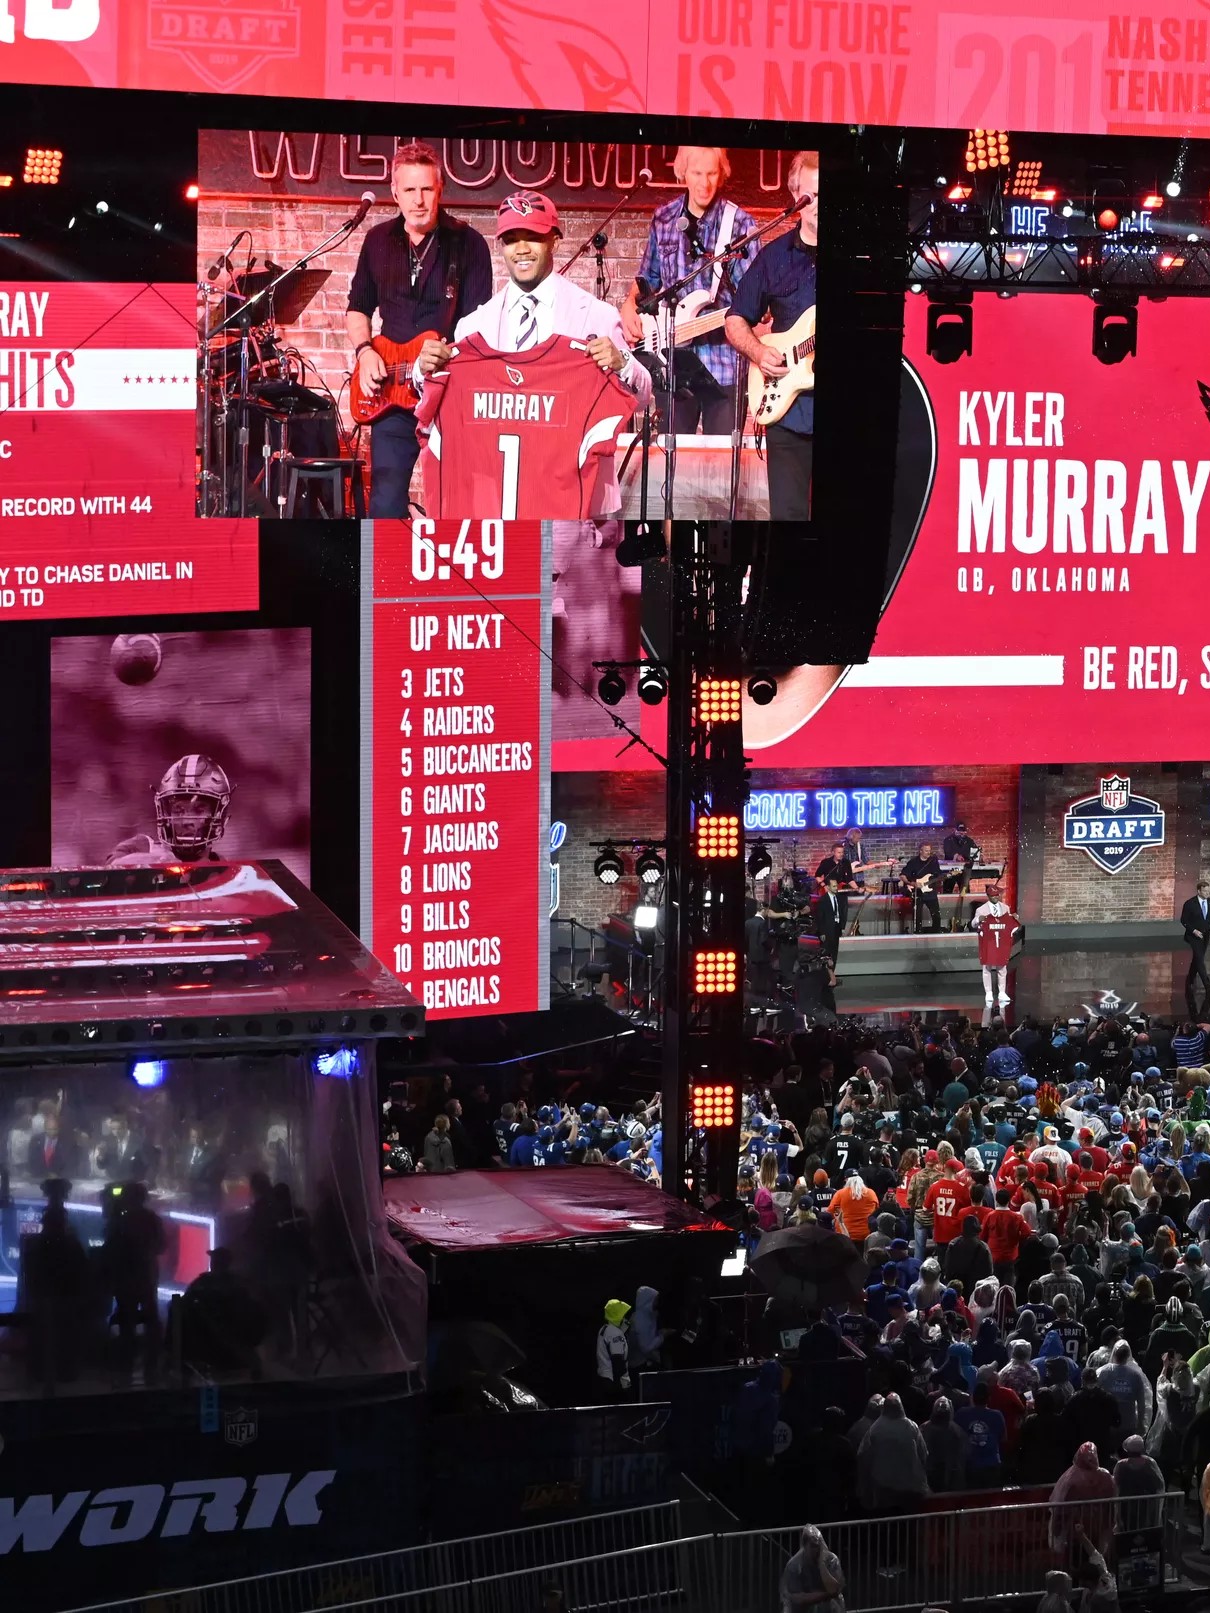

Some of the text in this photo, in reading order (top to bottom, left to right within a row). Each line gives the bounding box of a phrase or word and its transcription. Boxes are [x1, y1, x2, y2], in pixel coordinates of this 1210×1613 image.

[161, 13, 287, 43] DRAFT
[678, 0, 912, 55] OUR FUTURE
[676, 54, 908, 126] IS NOW
[473, 391, 556, 421] MURRAY
[958, 391, 1065, 447] KYLER
[497, 434, 521, 519] 1
[2, 495, 153, 516] RECORD WITH 44
[411, 519, 505, 581] 6:49
[15, 567, 39, 584] TO
[44, 564, 105, 583] CHASE
[109, 562, 172, 581] DANIEL
[176, 562, 193, 578] IN
[957, 567, 1130, 595] QB, OKLAHOMA
[20, 589, 44, 606] TD
[409, 613, 505, 651] UP NEXT
[400, 667, 464, 698] 3 JETS
[1083, 646, 1116, 690] BE
[1128, 645, 1188, 695] RED,
[400, 705, 495, 738] 4 RAIDERS
[400, 741, 532, 777] 5 BUCCANEERS
[400, 783, 486, 816] 6 GIANTS
[816, 791, 847, 827] TO
[853, 790, 897, 826] THE
[904, 789, 944, 824] NFL
[1104, 792, 1125, 807] NFL
[401, 821, 499, 856] 7 JAGUARS
[1072, 820, 1156, 839] DRAFT
[1103, 846, 1124, 855] 2019
[400, 862, 472, 894] 8 LIONS
[400, 901, 470, 933] 9 BILLS
[393, 938, 501, 973] 10 BRONCOS
[994, 931, 999, 948] 1
[423, 976, 500, 1009] BENGALS
[837, 1150, 848, 1170] 7
[936, 1196, 956, 1217] 87
[0, 1469, 338, 1556] WORK
